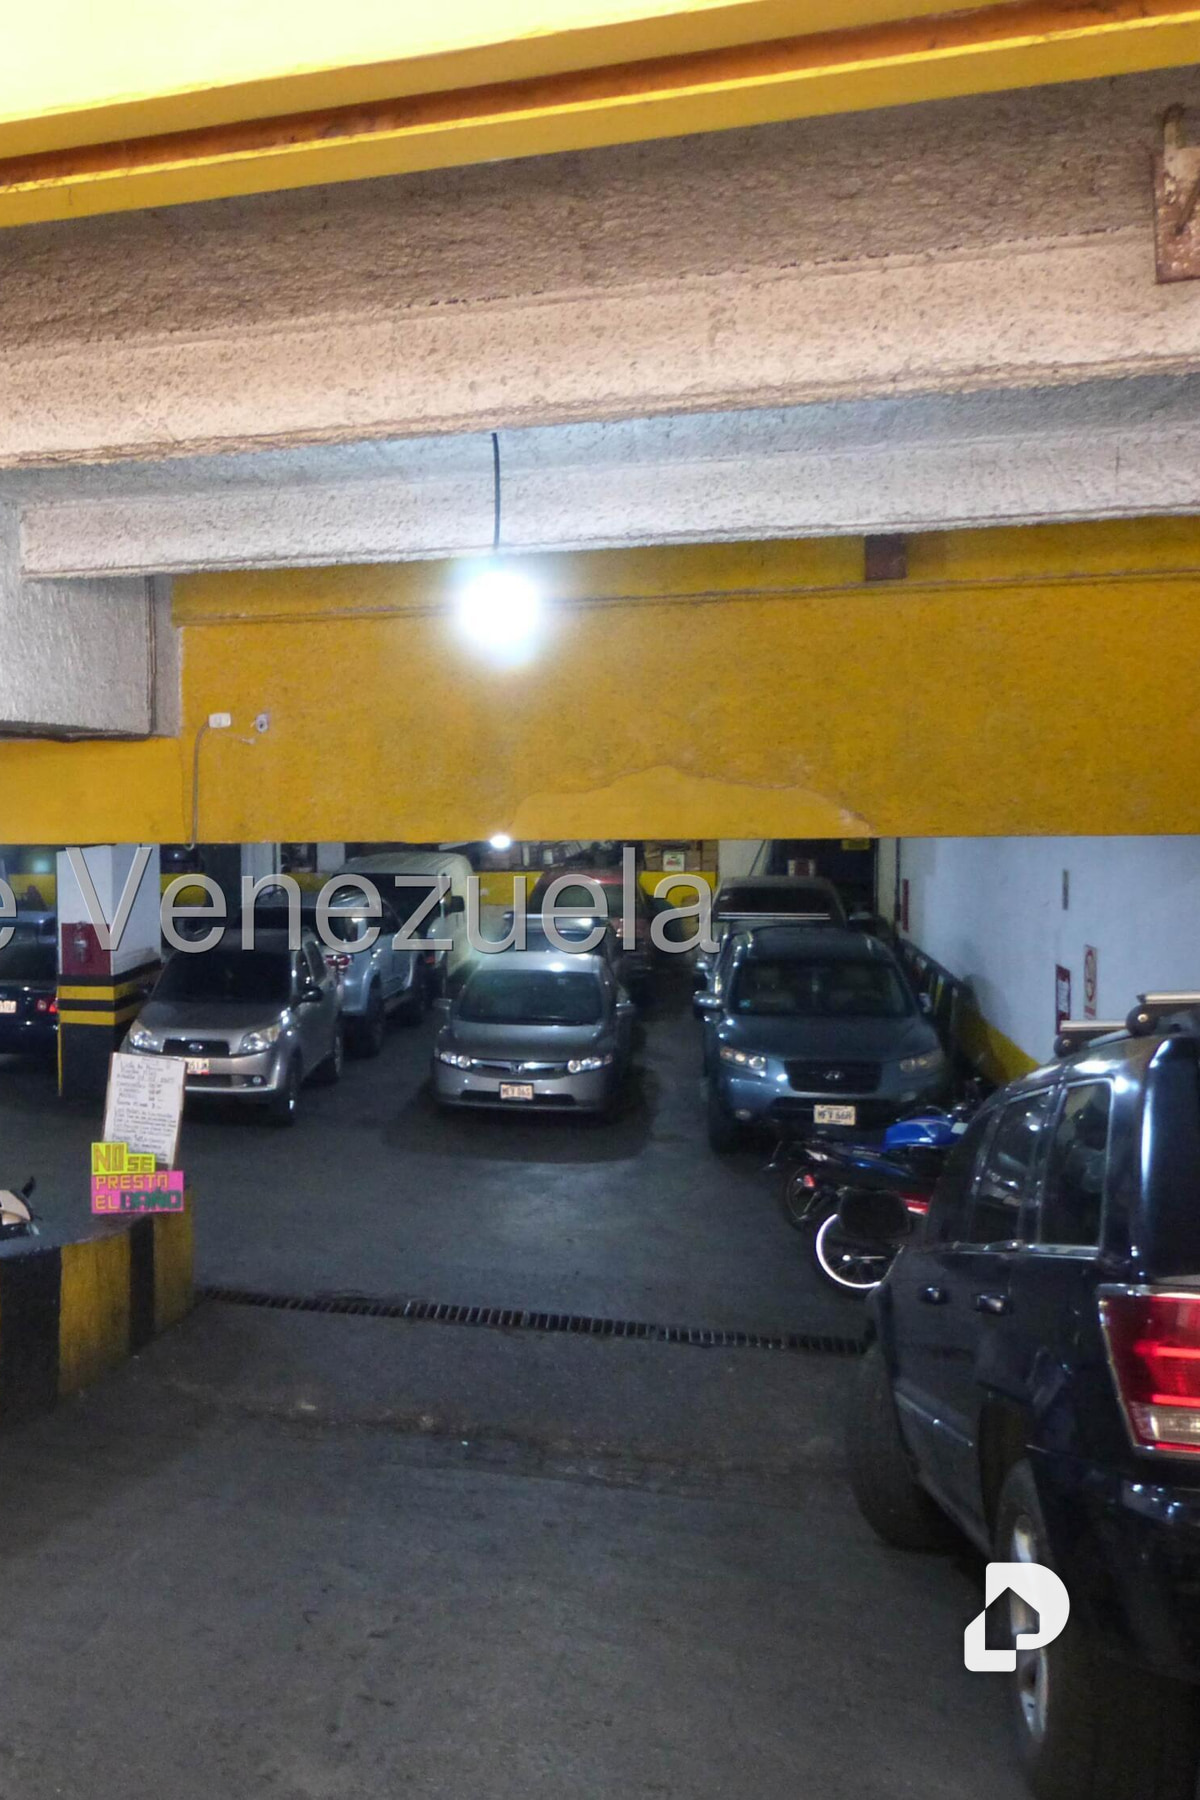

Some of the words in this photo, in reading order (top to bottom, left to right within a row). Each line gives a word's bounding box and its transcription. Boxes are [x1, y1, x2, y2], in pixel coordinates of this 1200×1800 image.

[93, 1144, 125, 1172] NO
[127, 1156, 153, 1172] SE
[95, 1195, 119, 1210] EL
